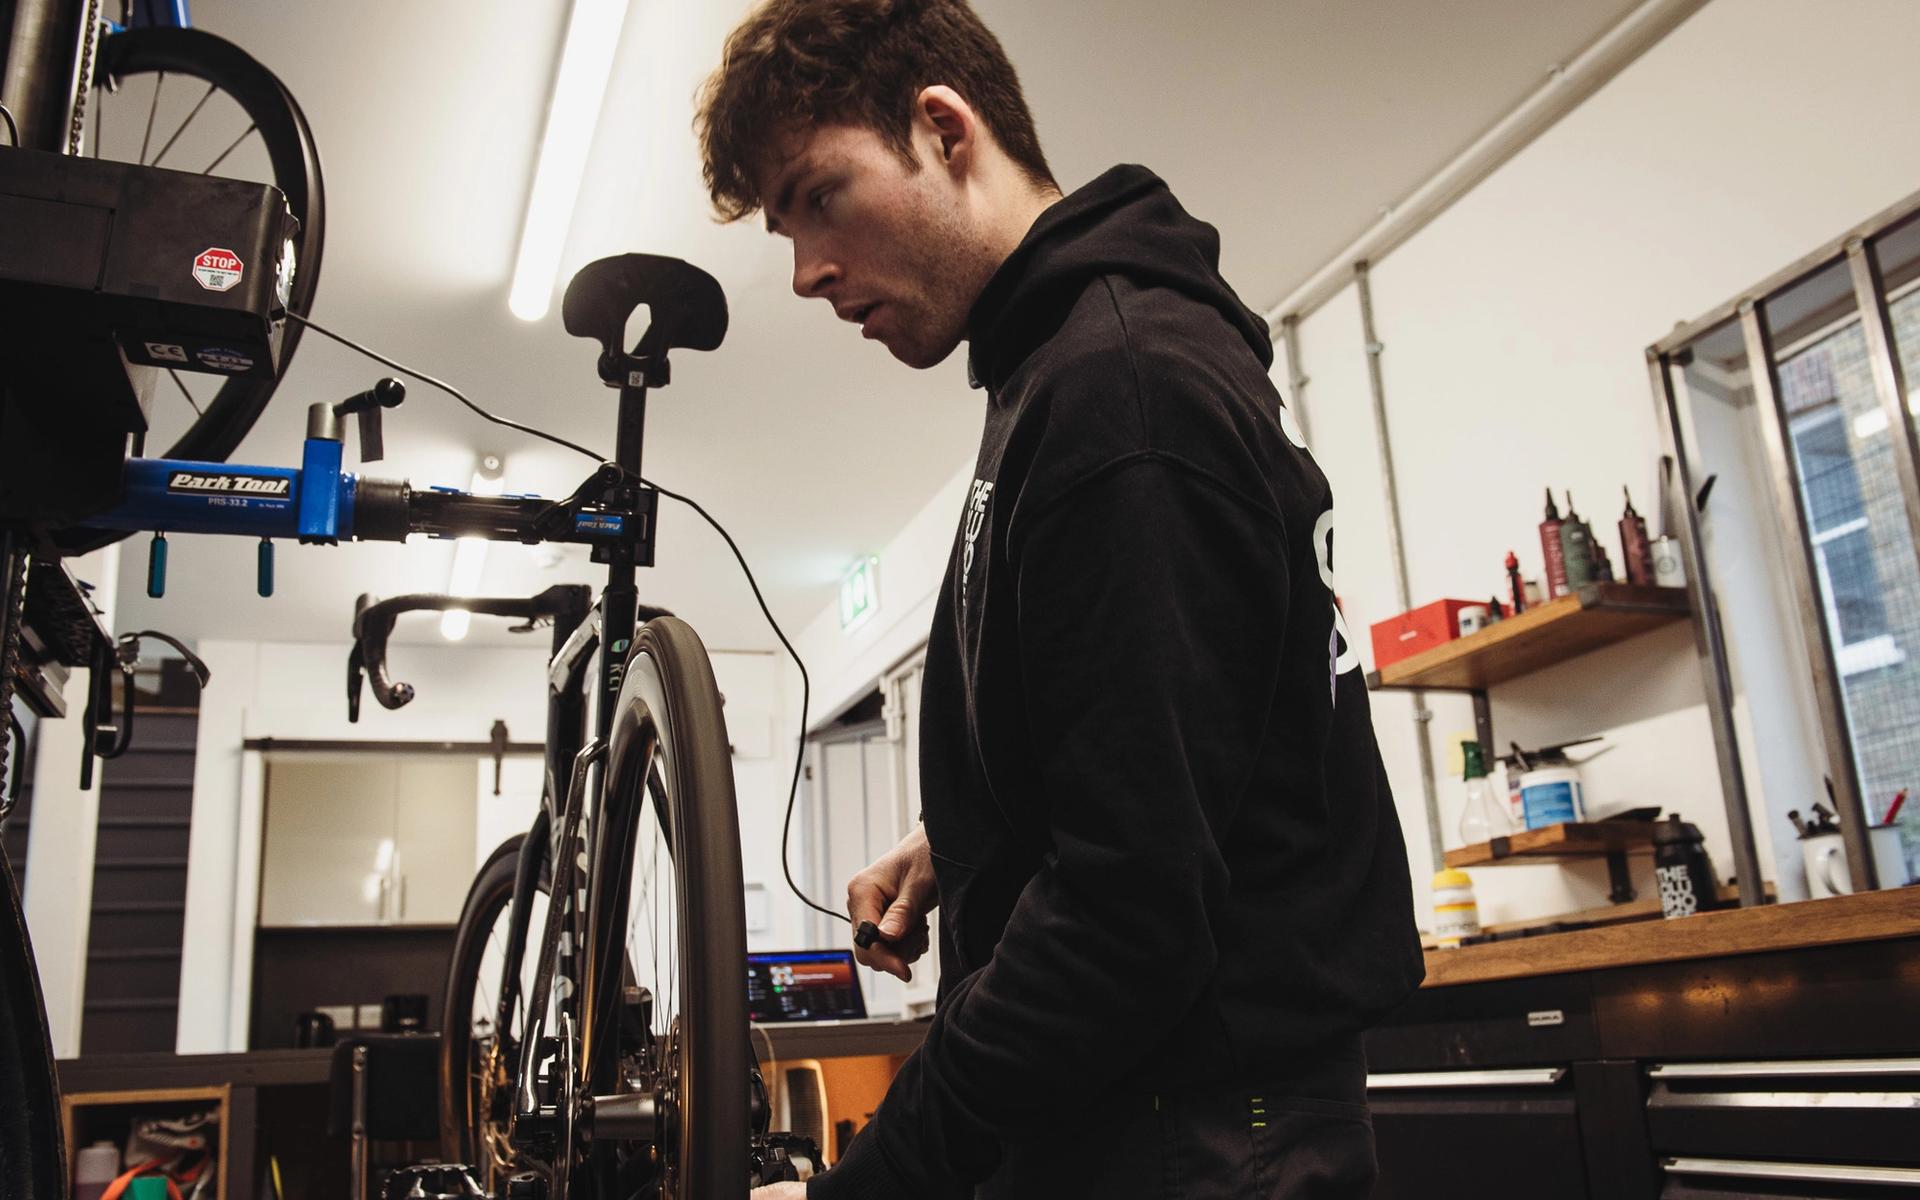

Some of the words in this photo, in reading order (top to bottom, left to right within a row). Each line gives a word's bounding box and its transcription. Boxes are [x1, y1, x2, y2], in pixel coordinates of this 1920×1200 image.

[202, 255, 237, 269] STOP
[150, 345, 182, 357] CE
[170, 474, 232, 490] Park
[233, 477, 289, 494] Tool
[208, 497, 248, 508] PRS-33.2
[970, 478, 994, 512] THE
[1656, 865, 1688, 883] THE
